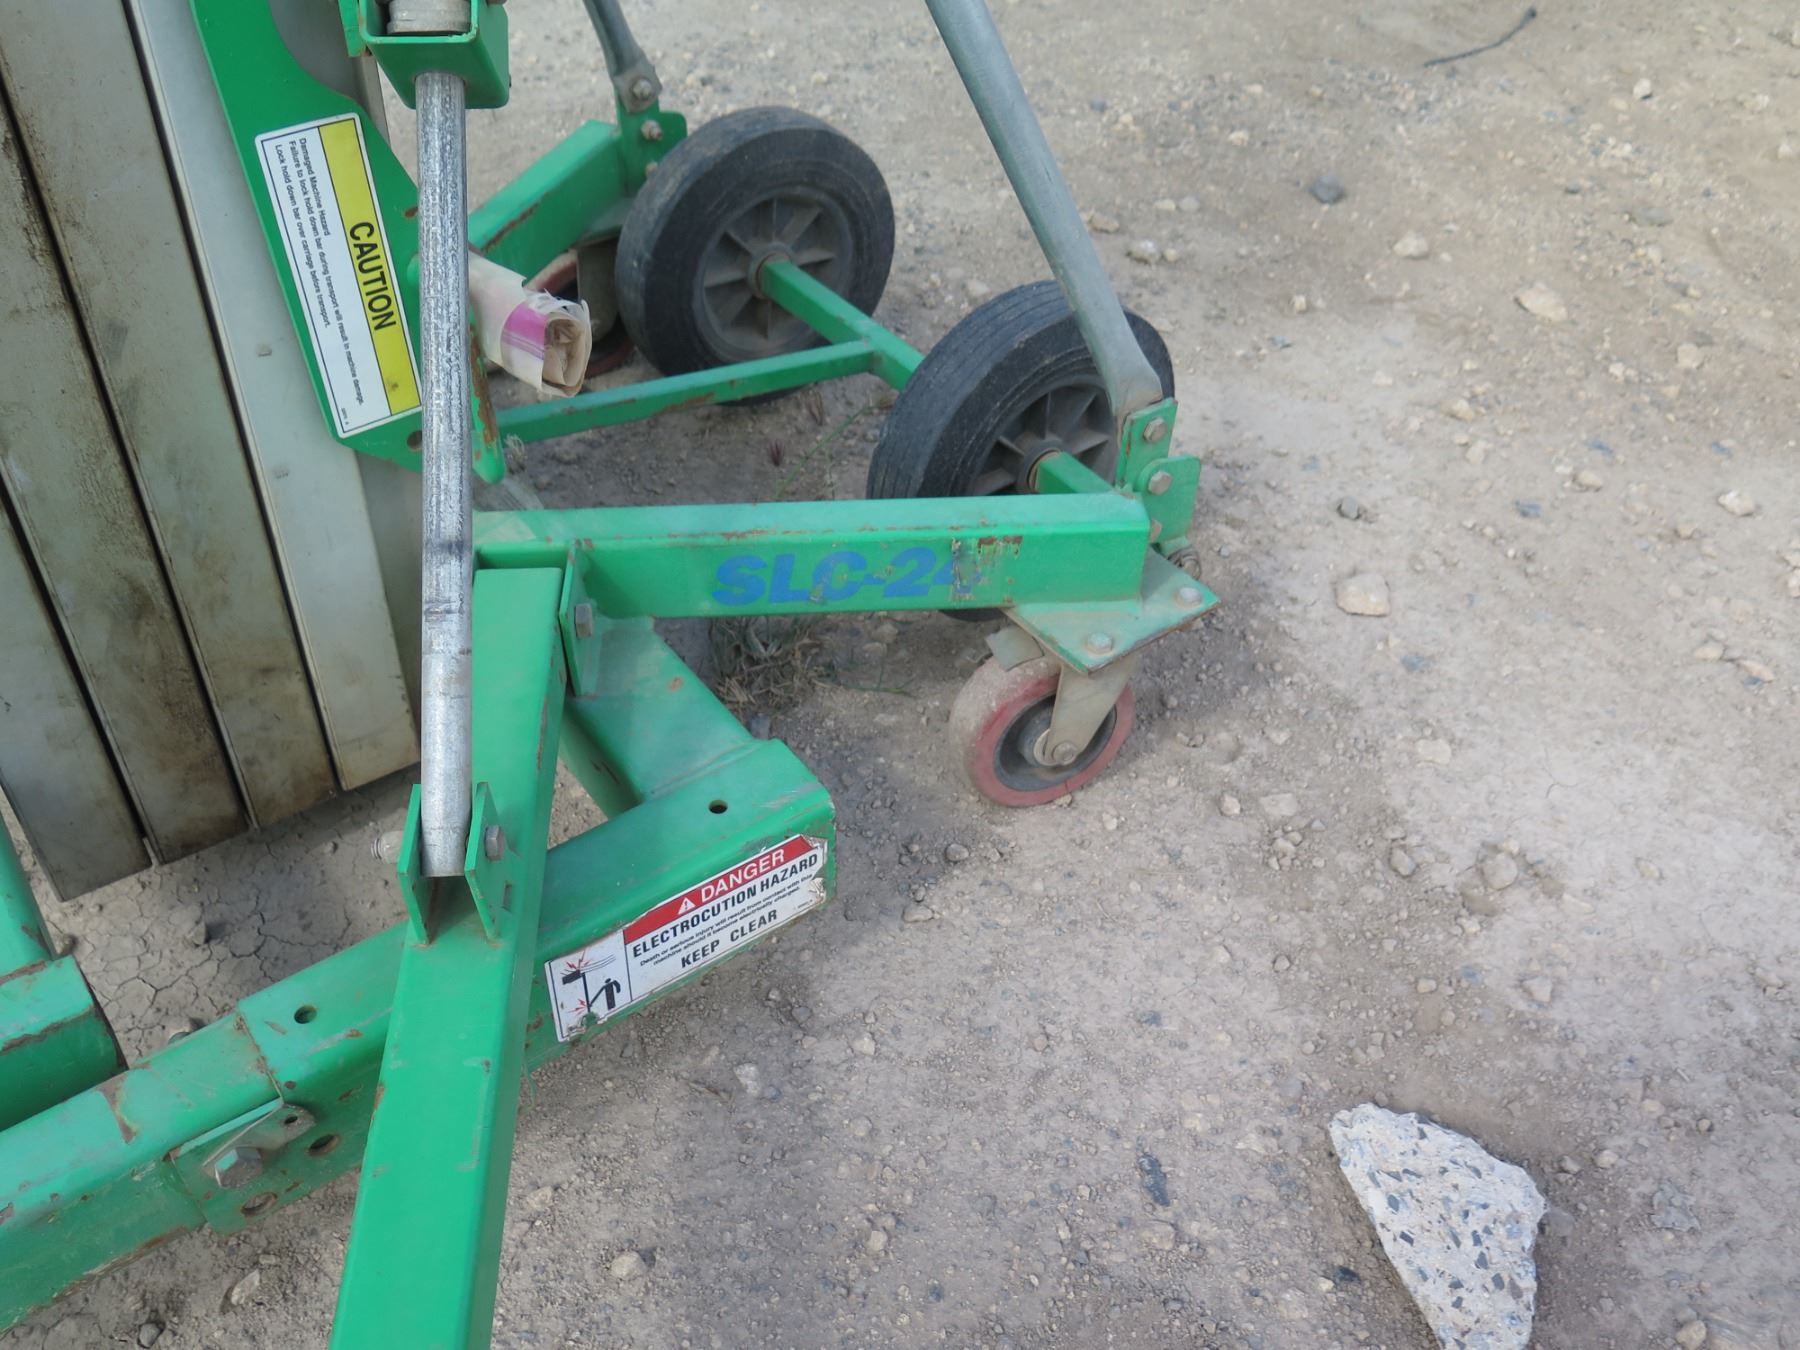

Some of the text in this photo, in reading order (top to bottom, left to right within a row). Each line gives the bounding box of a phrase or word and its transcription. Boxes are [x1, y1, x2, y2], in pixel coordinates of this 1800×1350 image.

[275, 144, 331, 328] Lock hold down bar over carriage before transport.
[290, 141, 301, 168] Failure
[296, 169, 304, 177] to
[300, 179, 308, 195] lock
[305, 197, 314, 214] hold
[310, 215, 319, 236] down
[319, 250, 330, 275] during
[325, 276, 338, 308] transport
[300, 138, 330, 236] Damaged Machine Hazard
[350, 221, 396, 331] CAUTION
[632, 853, 818, 958] ELECTROCUTION HAZARD
[701, 849, 785, 903] DANGER
[681, 909, 777, 968] KEEP CLEAR
